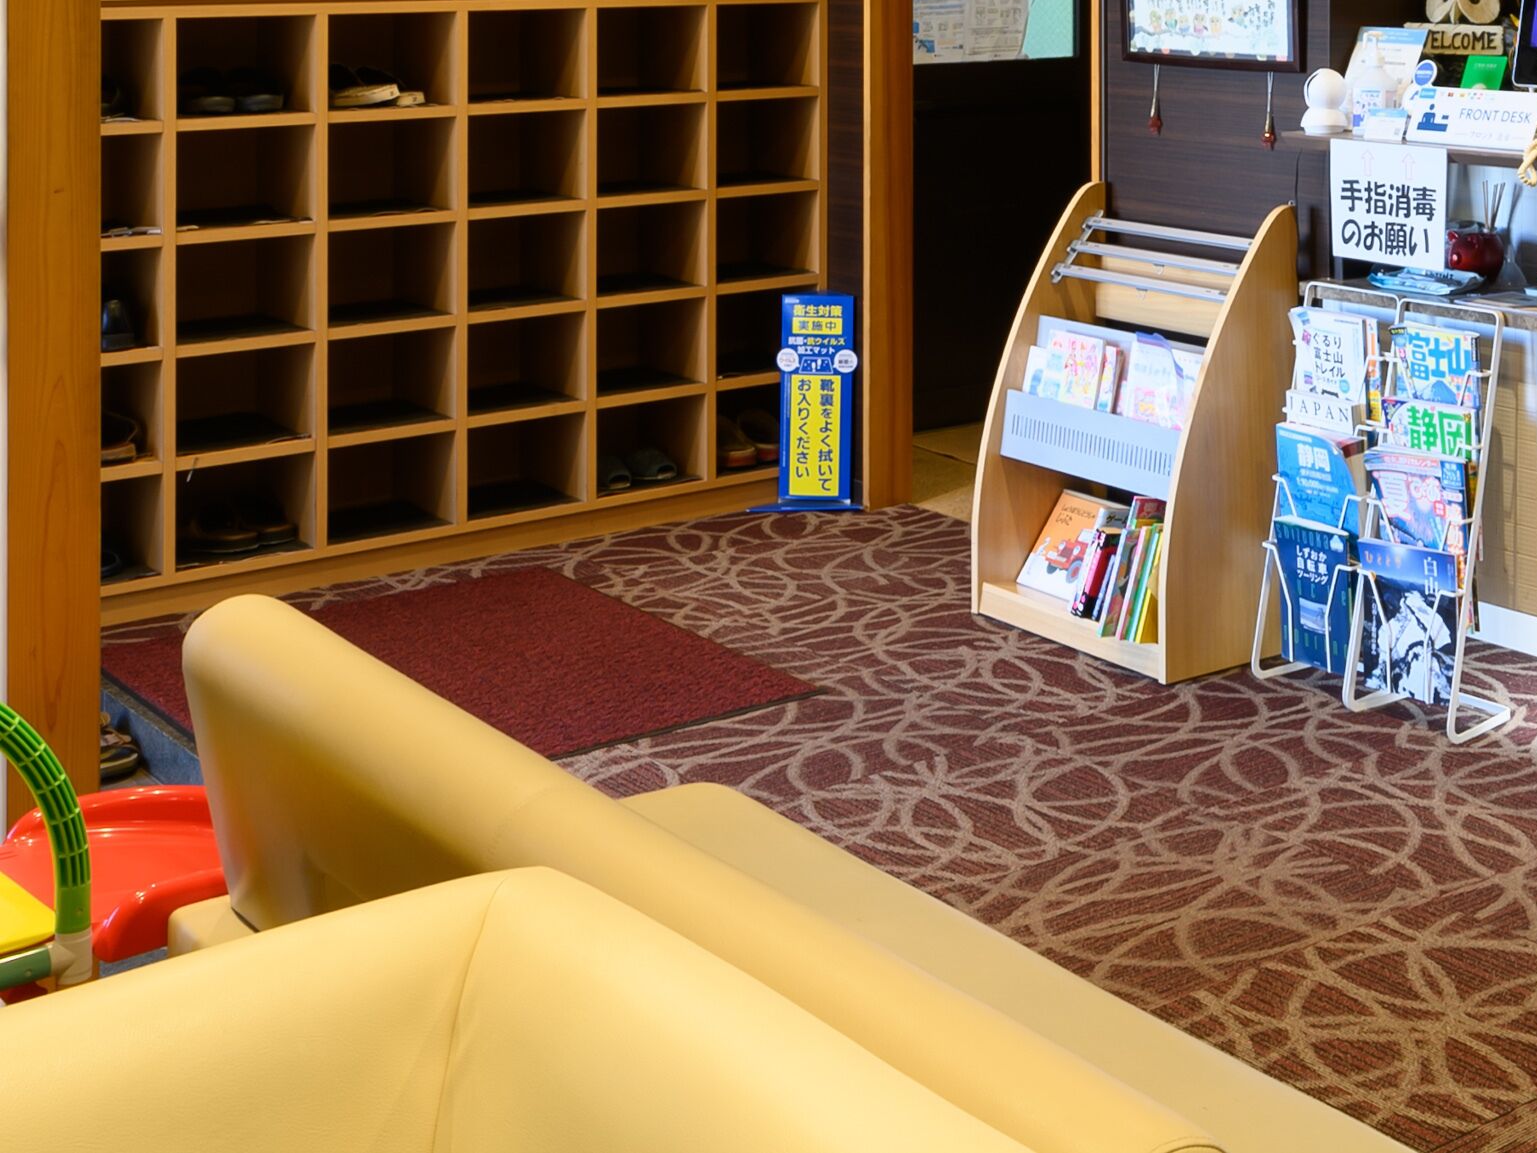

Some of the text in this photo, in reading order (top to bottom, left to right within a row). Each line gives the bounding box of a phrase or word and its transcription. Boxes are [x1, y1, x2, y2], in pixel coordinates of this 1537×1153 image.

[1430, 31, 1497, 51] ELCOME
[1459, 107, 1533, 124] FRONT DESK
[1340, 179, 1437, 222] 手指消毒
[1341, 218, 1430, 256] のお願い
[793, 304, 843, 317] 衛生対策
[798, 320, 837, 332] 実施中
[1313, 332, 1342, 349] くるり
[1313, 347, 1344, 365] 富士山
[1407, 332, 1473, 382] 富士山
[1315, 361, 1346, 379] トレイル
[1289, 396, 1350, 423] JAPAN
[795, 378, 812, 479] お入りください
[817, 378, 835, 492] 靴裏をよく拭いて
[1406, 405, 1465, 456] 静岡
[1296, 442, 1331, 473] 静岡
[1296, 557, 1329, 575] 自転車
[1423, 556, 1439, 596] 白山
